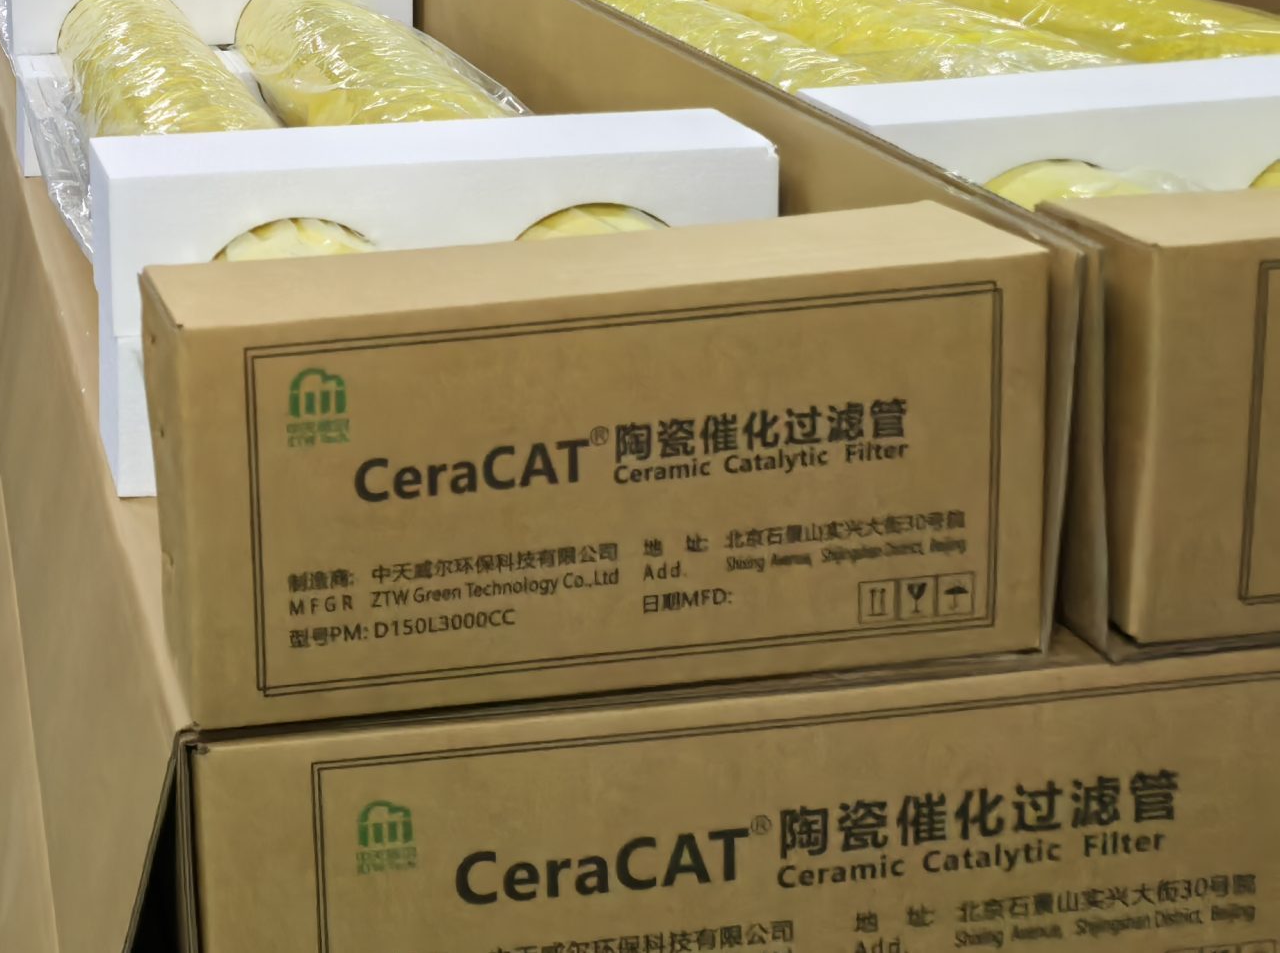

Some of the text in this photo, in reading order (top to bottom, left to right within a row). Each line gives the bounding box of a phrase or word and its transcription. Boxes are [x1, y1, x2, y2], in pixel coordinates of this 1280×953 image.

[614, 398, 907, 464] 陶瓷催化过滤管
[613, 441, 909, 485] Ceramic Catalytic Filter
[370, 587, 410, 609] ZTW
[413, 587, 462, 605] Green
[465, 571, 558, 598] Technology
[374, 608, 517, 640] D150L3000CC
[779, 769, 1180, 861] 陶瓷催化过滤管
[777, 829, 1167, 890] Ceramic Catalytic Filter
